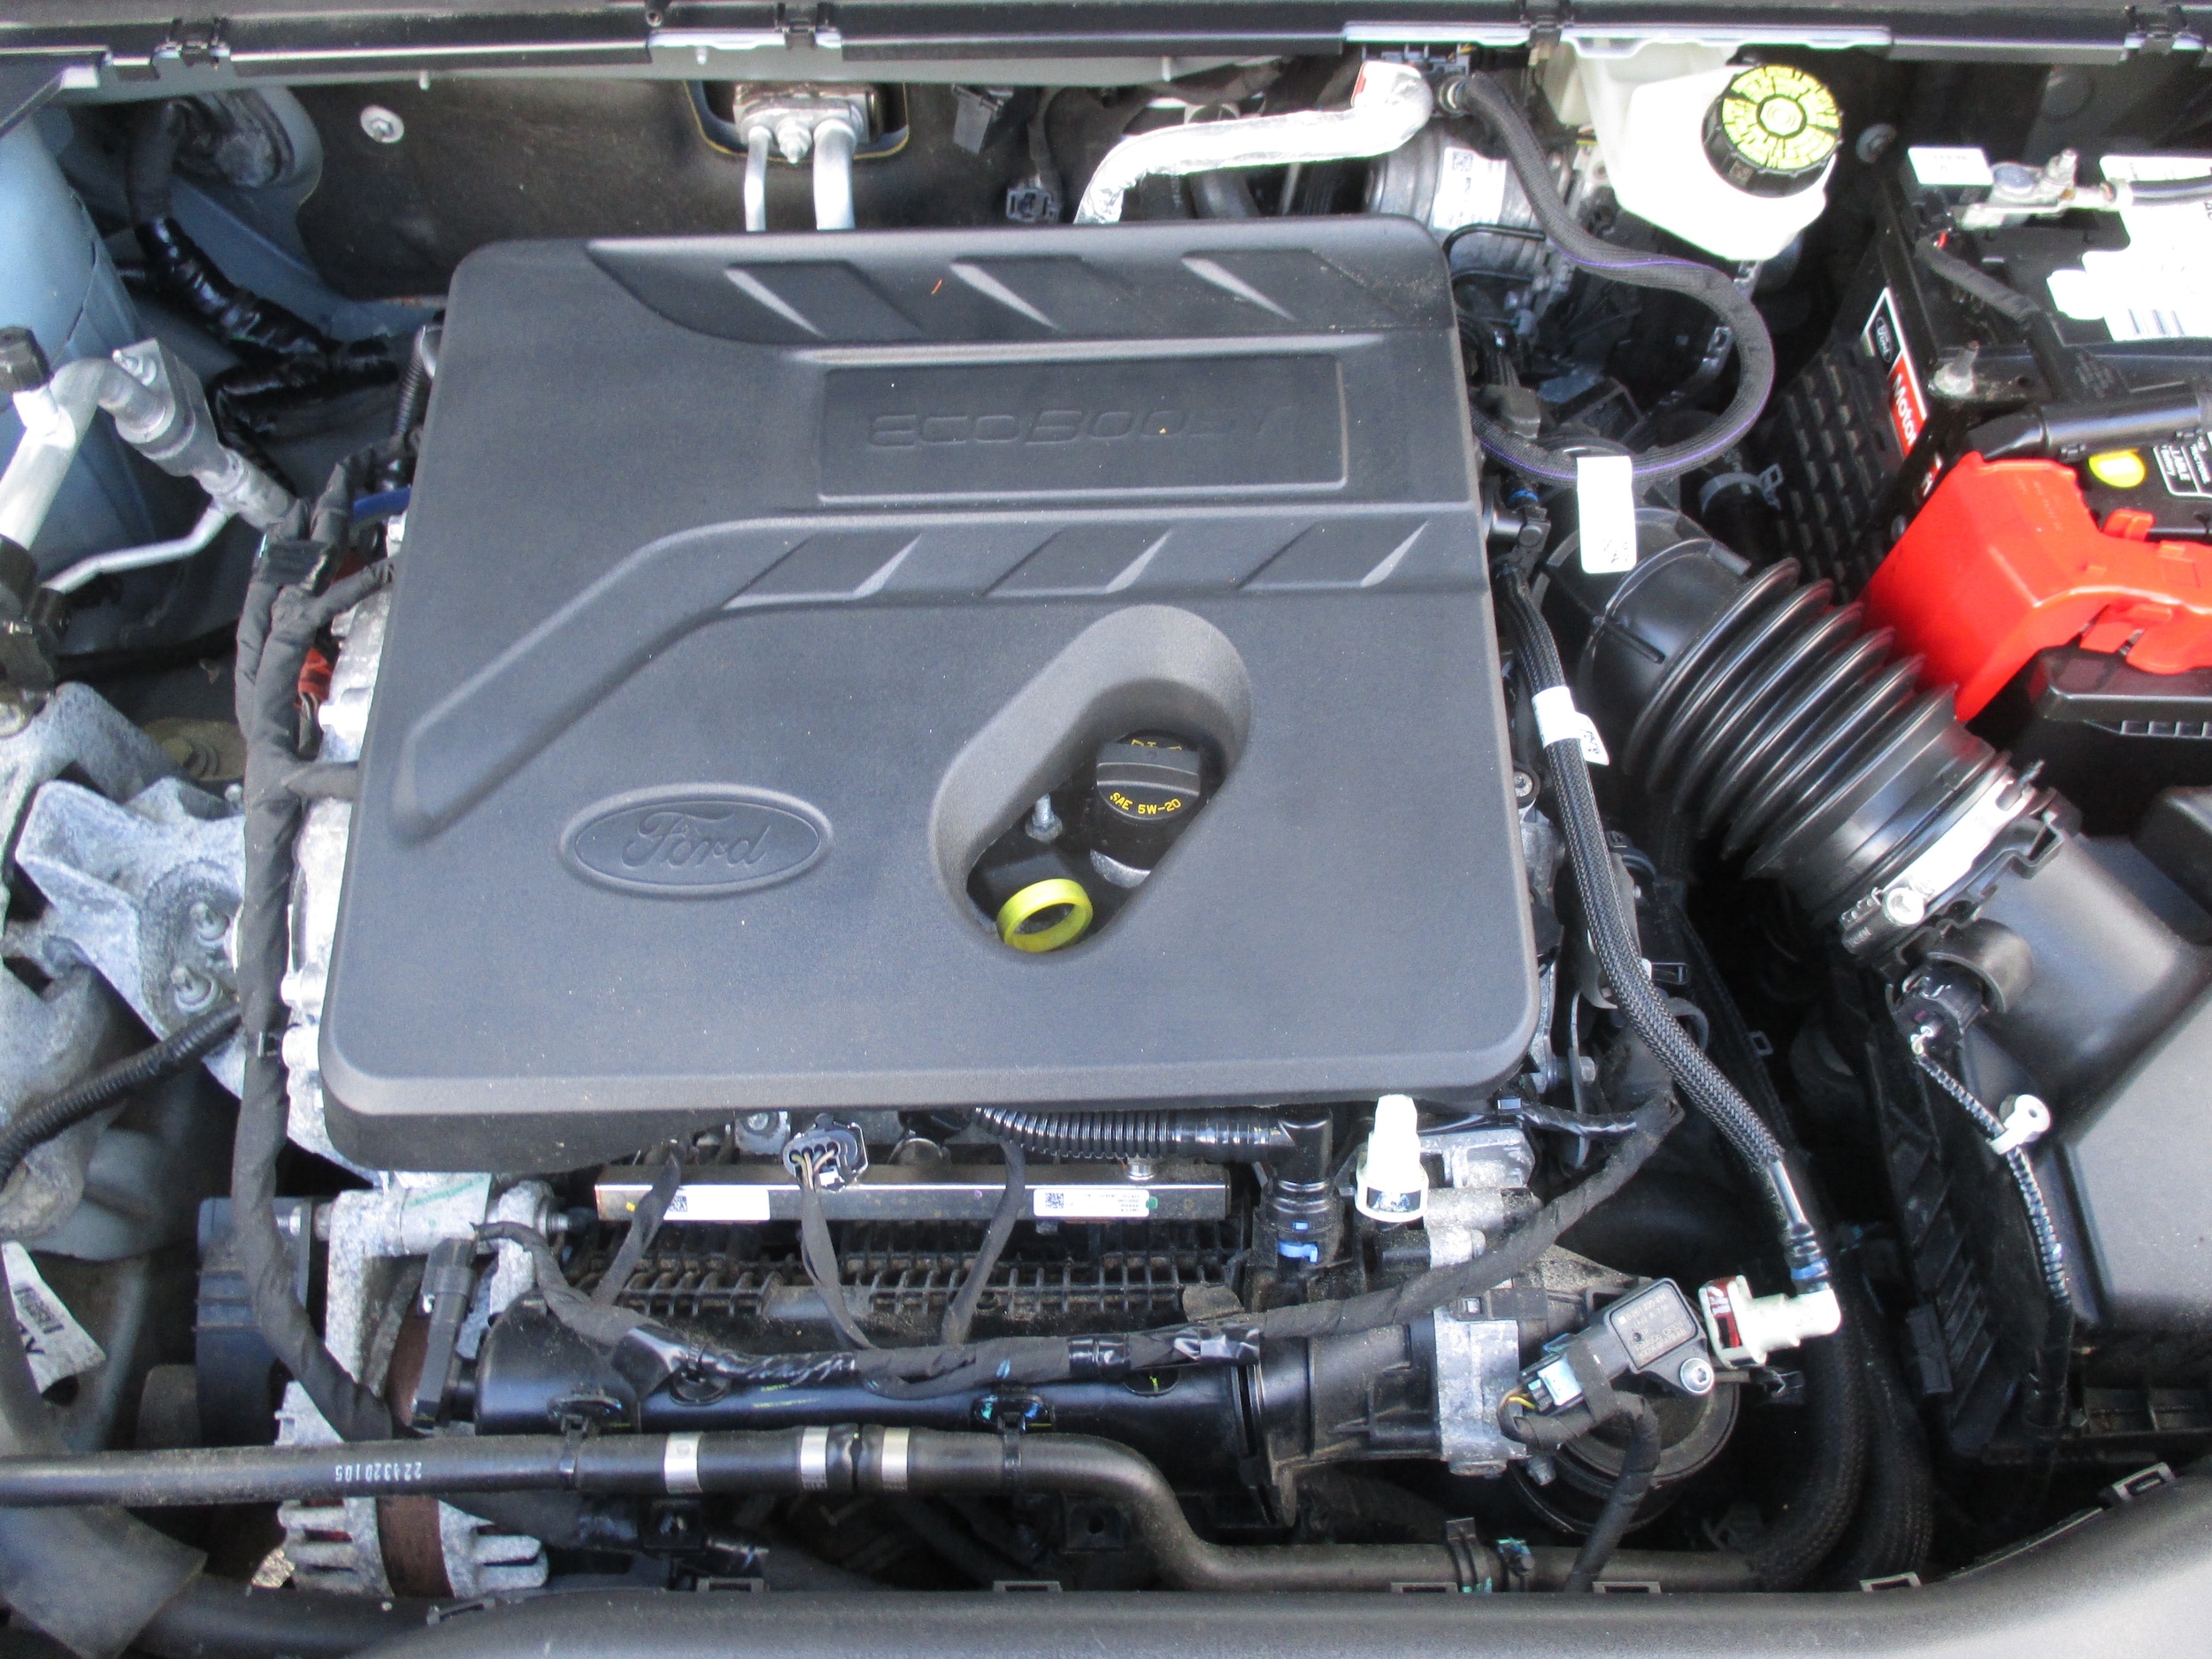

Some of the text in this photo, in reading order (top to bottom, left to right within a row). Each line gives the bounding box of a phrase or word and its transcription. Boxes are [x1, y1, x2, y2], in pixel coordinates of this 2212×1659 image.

[1110, 792, 1182, 815] SAE 5W-20
[621, 810, 772, 867] Ford
